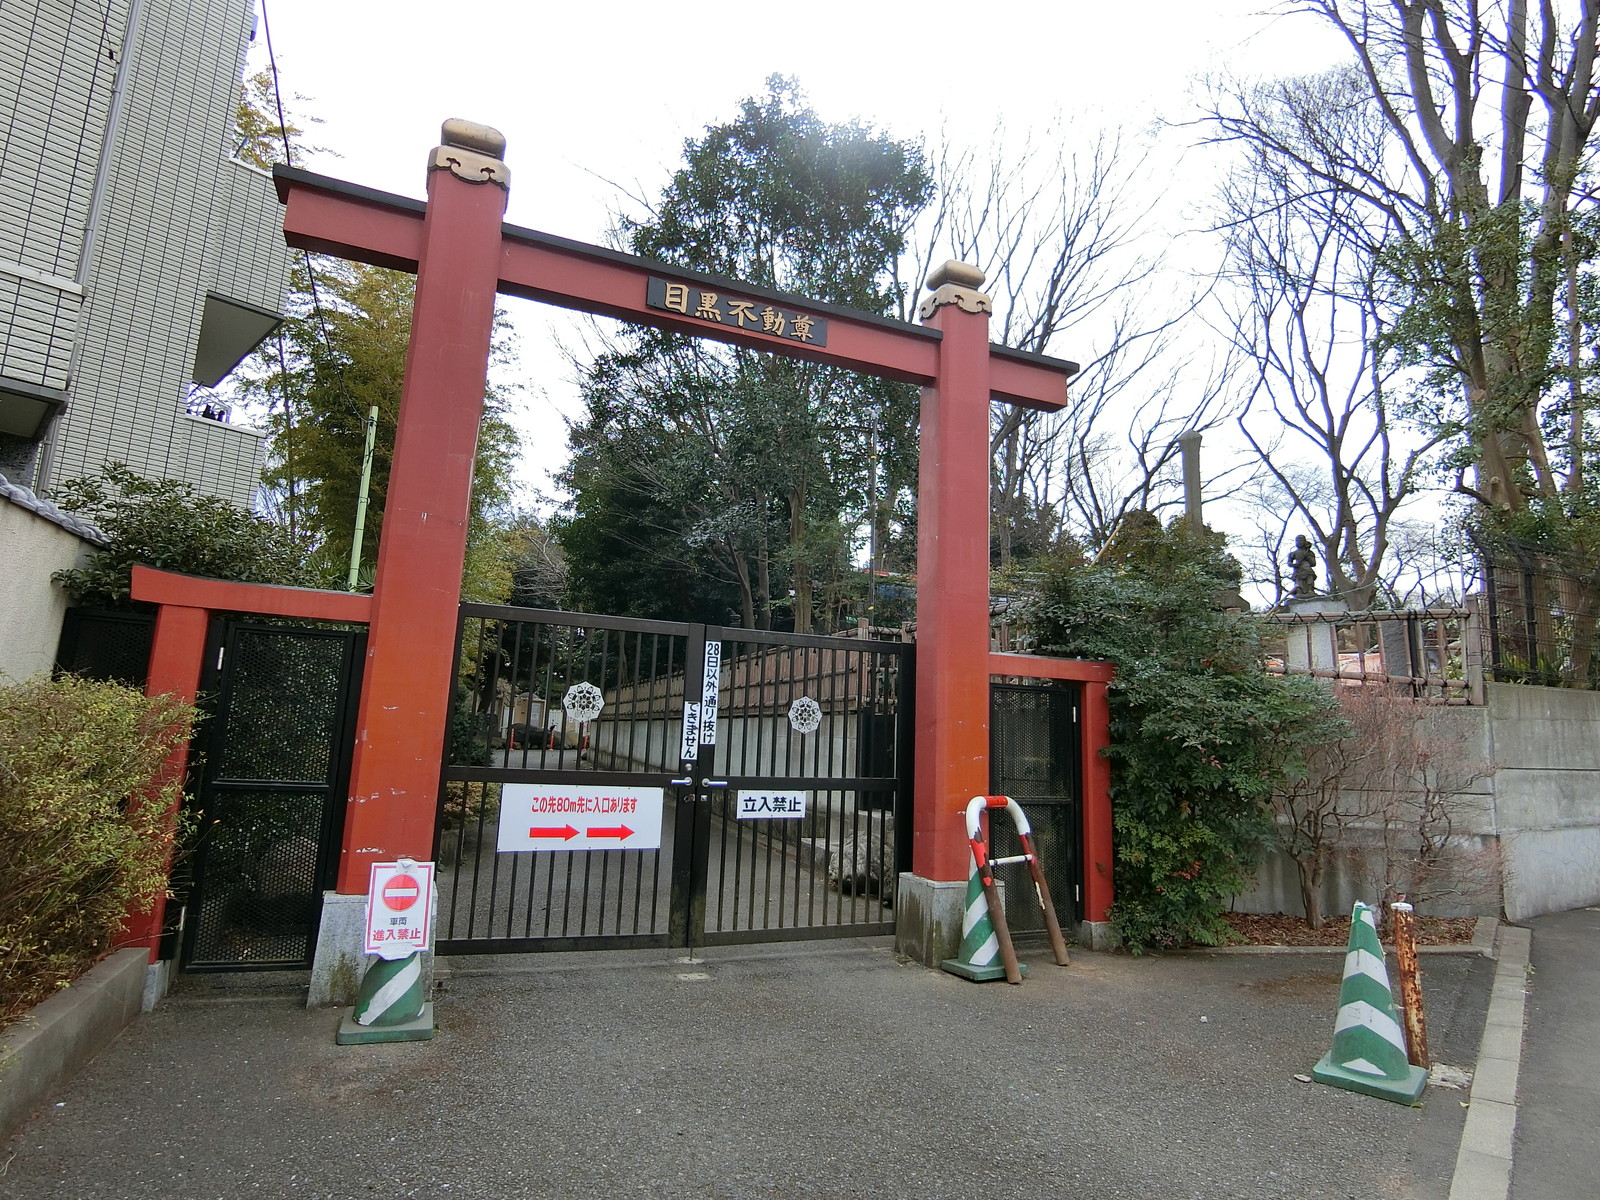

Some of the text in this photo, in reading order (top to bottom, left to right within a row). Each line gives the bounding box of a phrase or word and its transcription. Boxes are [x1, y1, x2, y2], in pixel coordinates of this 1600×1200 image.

[664, 282, 815, 342] 目黒不動尊
[684, 702, 699, 759] できません
[531, 796, 638, 813] この先80m先に入口あります
[742, 796, 802, 812] 立入禁止
[390, 916, 407, 926] 車両
[372, 928, 422, 941] 進入禁止
